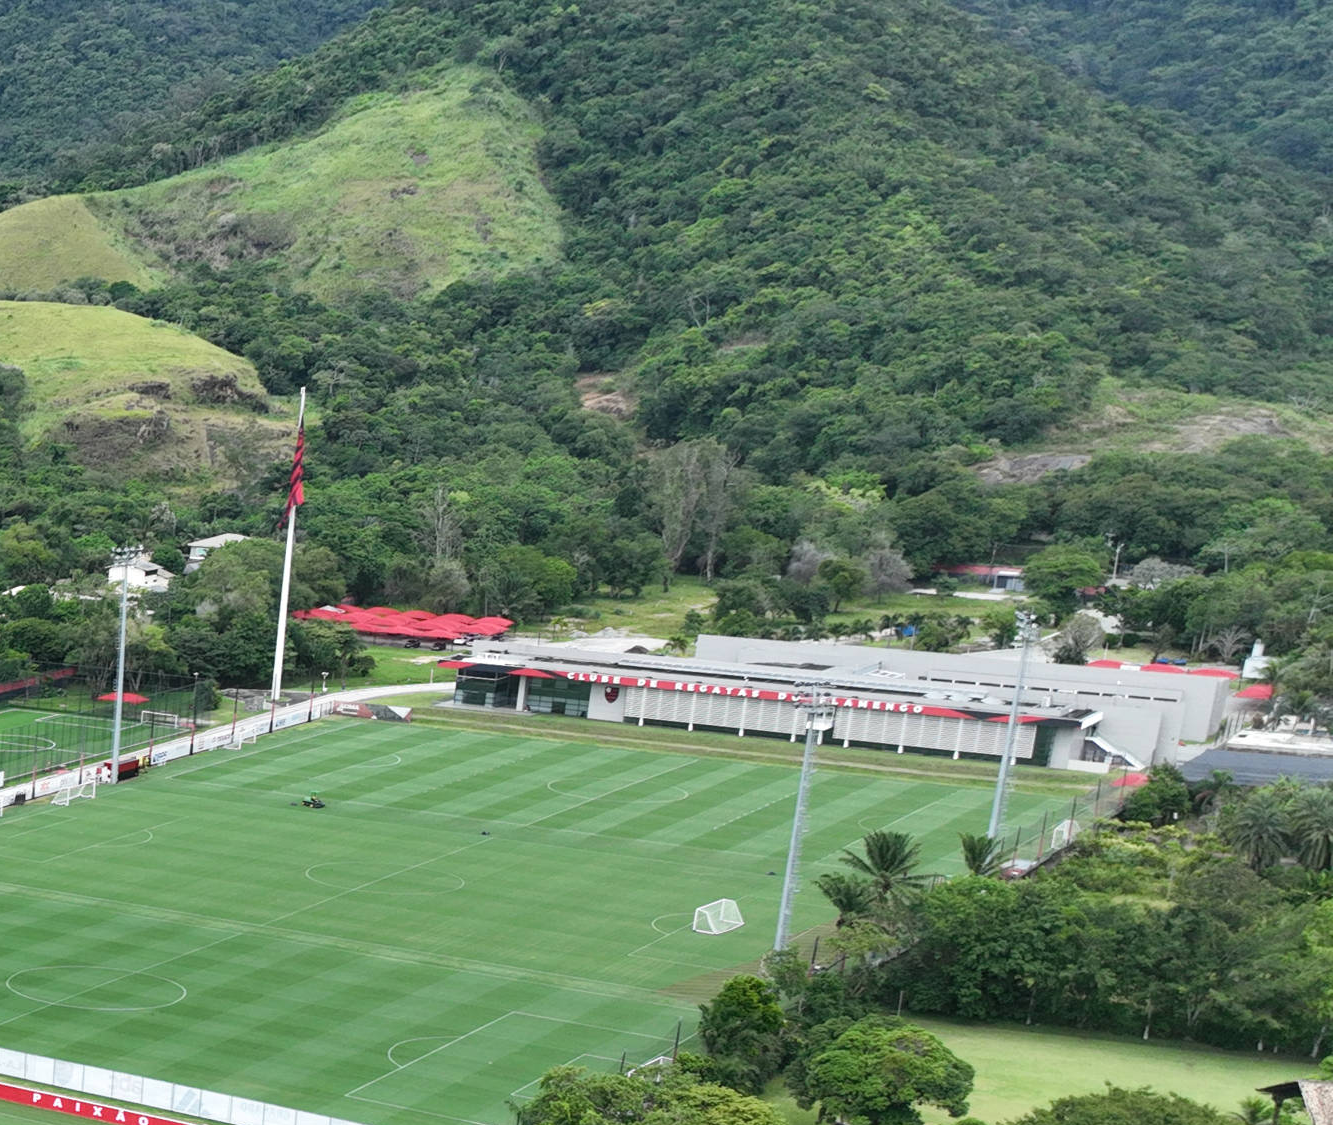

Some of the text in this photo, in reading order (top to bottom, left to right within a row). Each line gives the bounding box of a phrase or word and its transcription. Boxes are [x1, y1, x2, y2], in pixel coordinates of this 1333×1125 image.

[567, 672, 621, 685] CLUBE
[637, 678, 658, 689] DE
[674, 682, 760, 698] REGATAS
[819, 698, 924, 713] FLAMENGO
